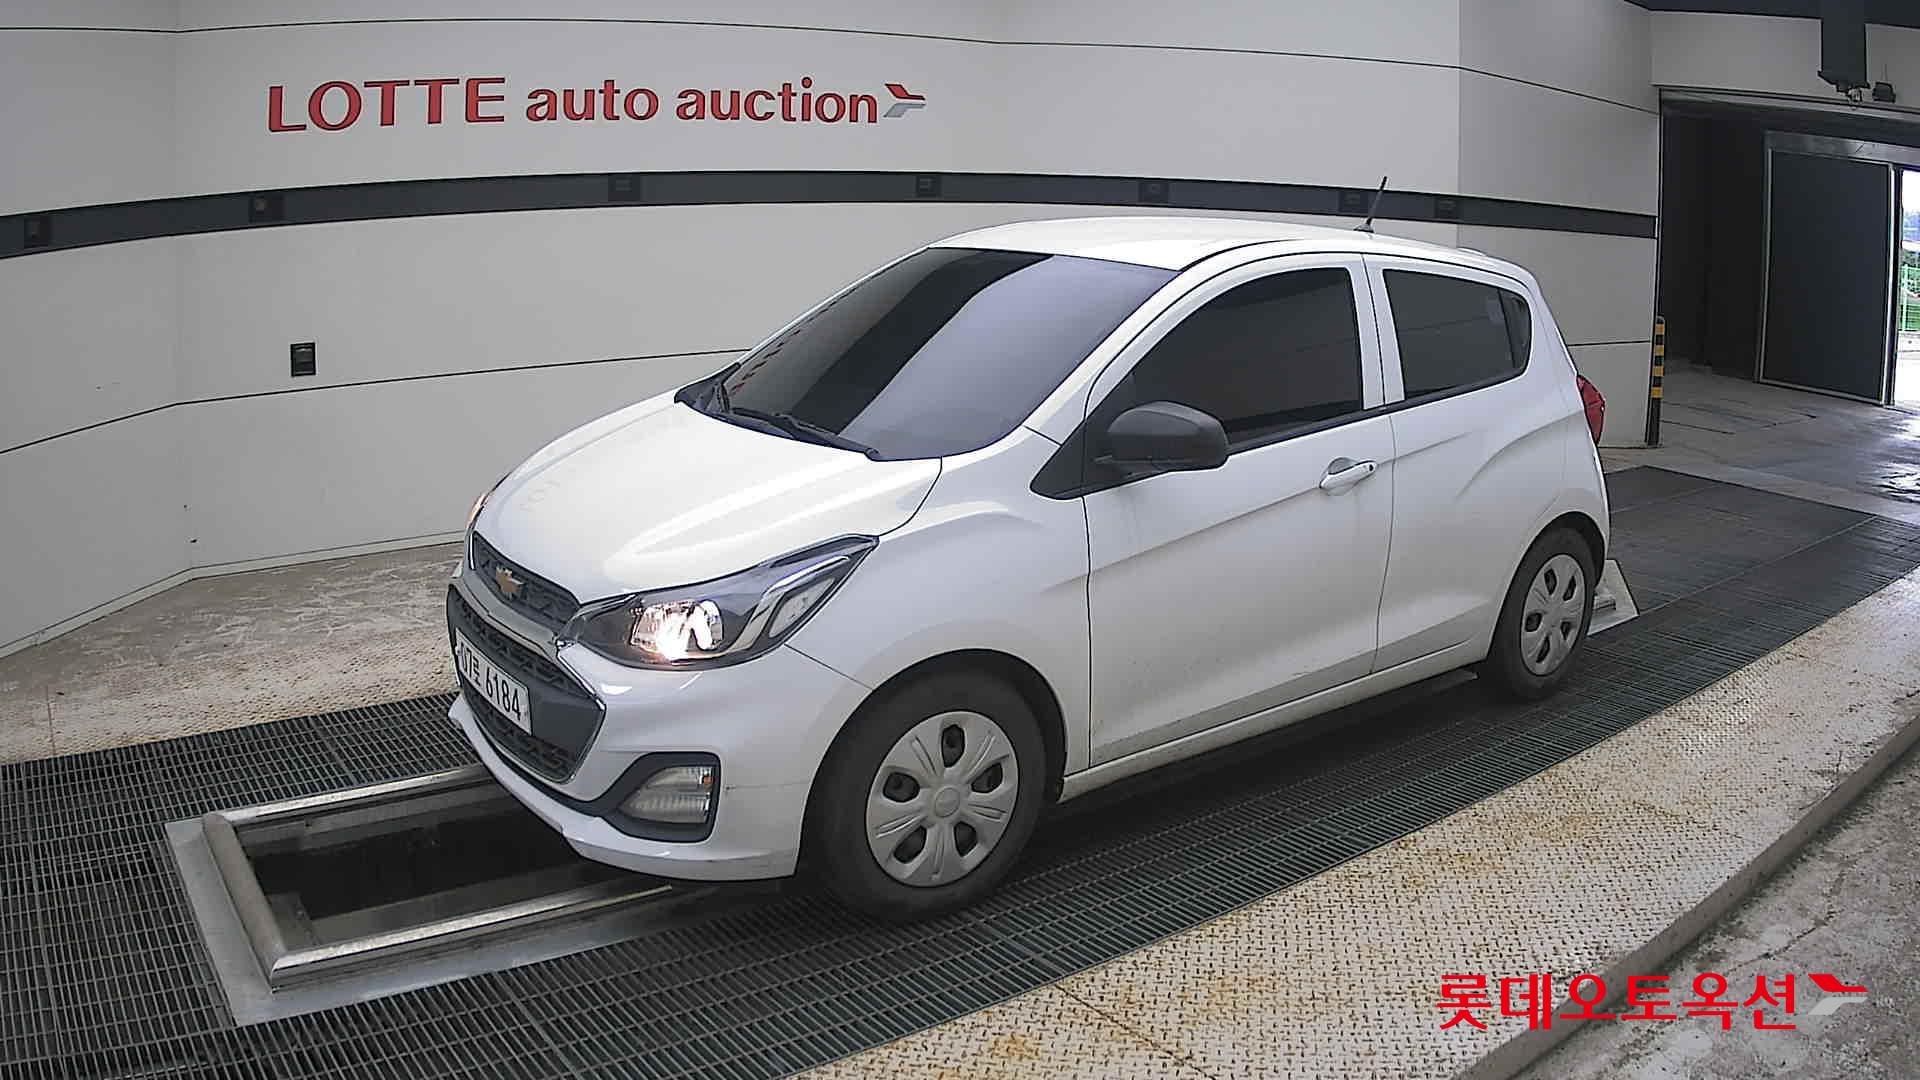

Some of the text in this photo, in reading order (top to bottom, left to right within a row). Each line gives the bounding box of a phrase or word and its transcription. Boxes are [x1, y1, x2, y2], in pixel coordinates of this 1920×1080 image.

[268, 77, 878, 133] LOTTE auto auction
[486, 667, 521, 721] 6184
